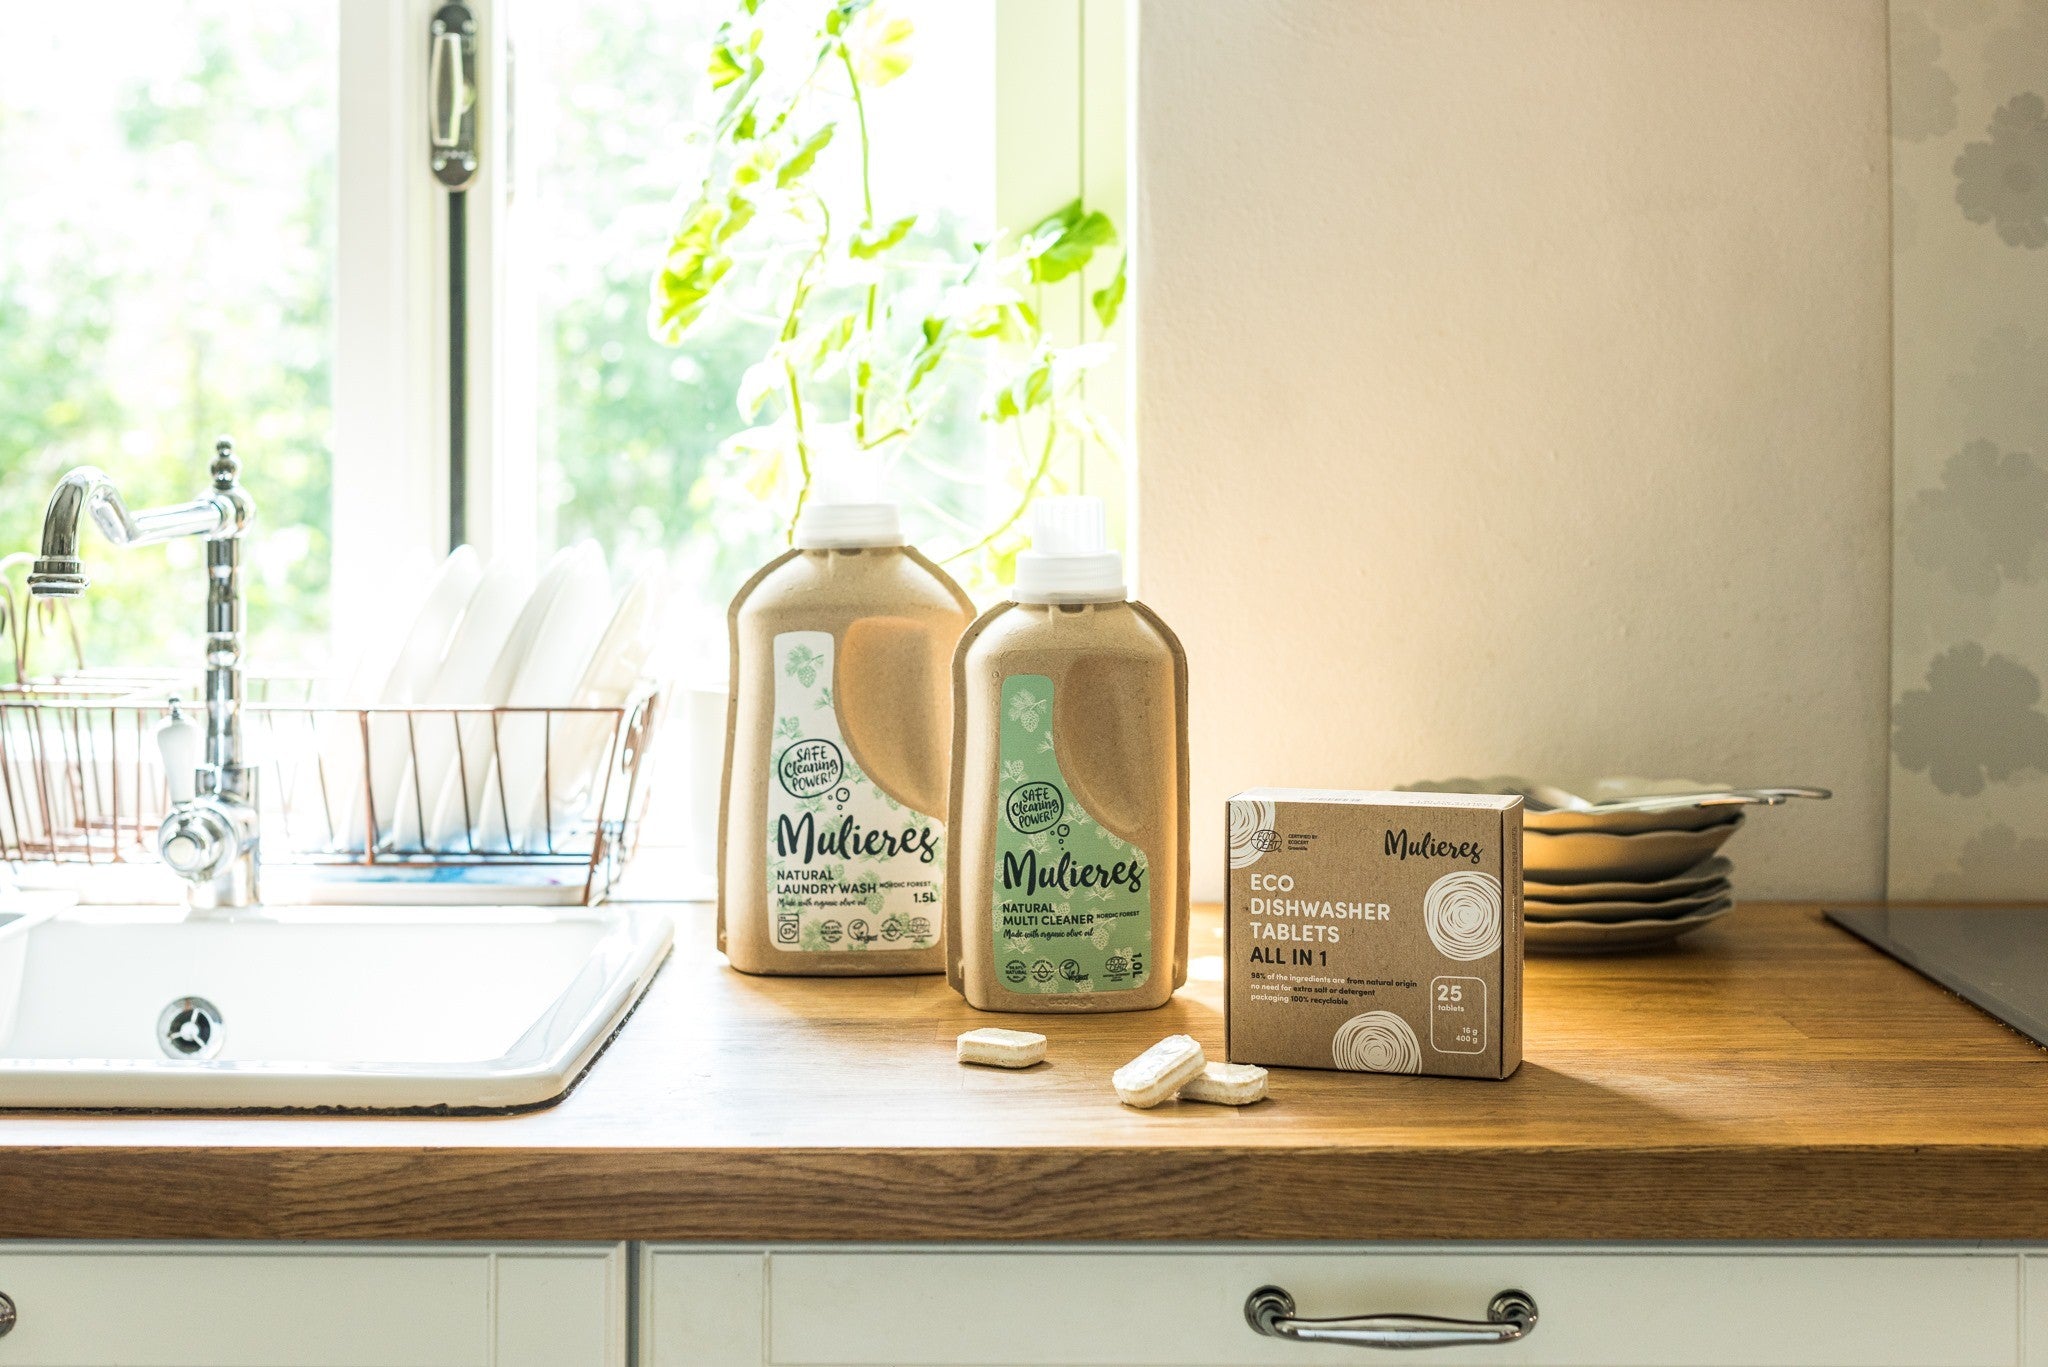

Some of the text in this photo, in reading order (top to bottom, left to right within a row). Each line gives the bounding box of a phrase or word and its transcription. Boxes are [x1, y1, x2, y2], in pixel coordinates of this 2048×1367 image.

[796, 745, 828, 763] SAFE
[784, 759, 839, 778] Cleaning
[792, 772, 833, 792] POWER!
[1022, 787, 1050, 803] SAFE
[1011, 799, 1060, 817] Cleaning
[1018, 810, 1054, 828] POWER!
[777, 811, 939, 865] Mulieres
[1384, 828, 1484, 865] Mulieres
[777, 870, 834, 881] NATURAL
[1003, 849, 1145, 896] Mulieres
[777, 883, 877, 895] LAUNDRY WASH
[1250, 873, 1295, 892] ECO
[913, 892, 937, 904] 1.5L
[1002, 903, 1055, 914] NATURAL
[1119, 910, 1140, 918] FOREST
[1250, 897, 1391, 921] DISHWASHER
[1002, 914, 1094, 926] MULTI CLEANER
[1003, 927, 1095, 941] Made with organic olive oil
[1250, 921, 1340, 944] TABLETS
[1250, 946, 1327, 967] ALL IN 1
[1276, 973, 1288, 981] the
[1289, 974, 1331, 984] ingredients
[1346, 976, 1365, 985] from
[1366, 978, 1394, 987] natural
[1395, 980, 1418, 989] origin
[1261, 983, 1280, 991] need
[1280, 983, 1292, 991] for
[1293, 985, 1313, 993] extra
[1313, 985, 1328, 994] salt
[1338, 987, 1376, 997] detergent
[1437, 984, 1463, 1002] 25
[1250, 993, 1349, 1006] packaging 100% recyclable
[1437, 1004, 1465, 1012] tablets
[1472, 1037, 1478, 1045] g
